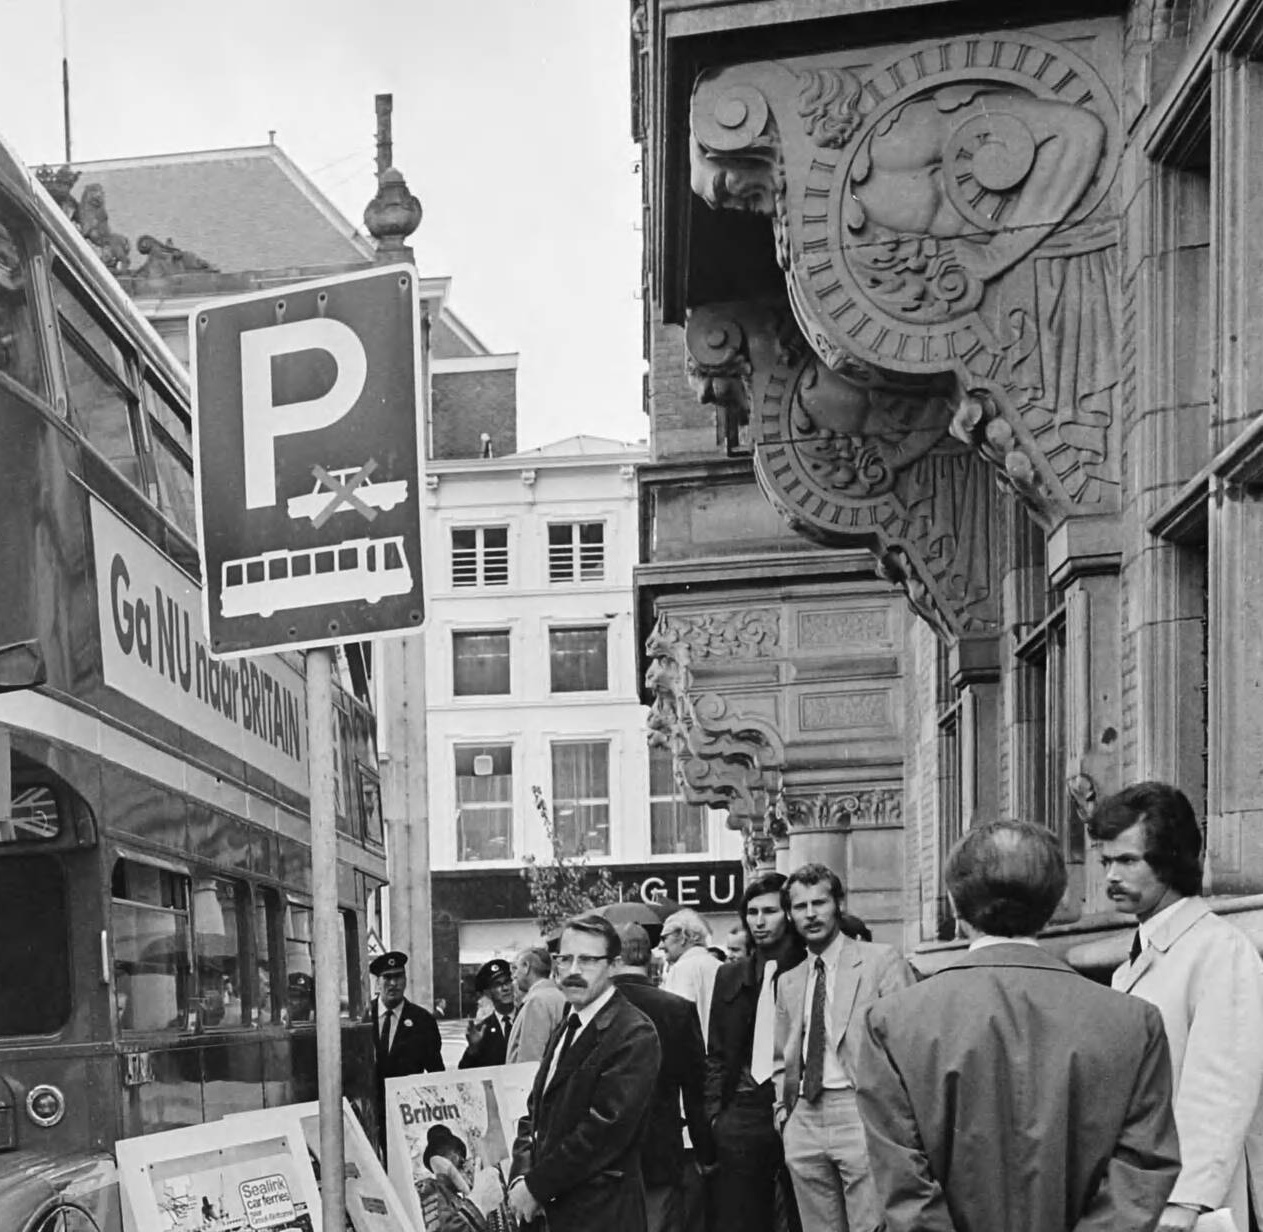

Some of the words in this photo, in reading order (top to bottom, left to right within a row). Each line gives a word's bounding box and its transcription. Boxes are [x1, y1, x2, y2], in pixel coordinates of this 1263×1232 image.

[239, 317, 368, 510] P
[110, 553, 153, 668] Ga
[155, 584, 192, 693] NU
[195, 641, 238, 724] naar
[239, 656, 301, 762] BRITAIN
[399, 1097, 460, 1125] Britain
[242, 1178, 286, 1198] Sealink
[247, 1199, 262, 1209] car
[262, 1193, 290, 1206] ferries
